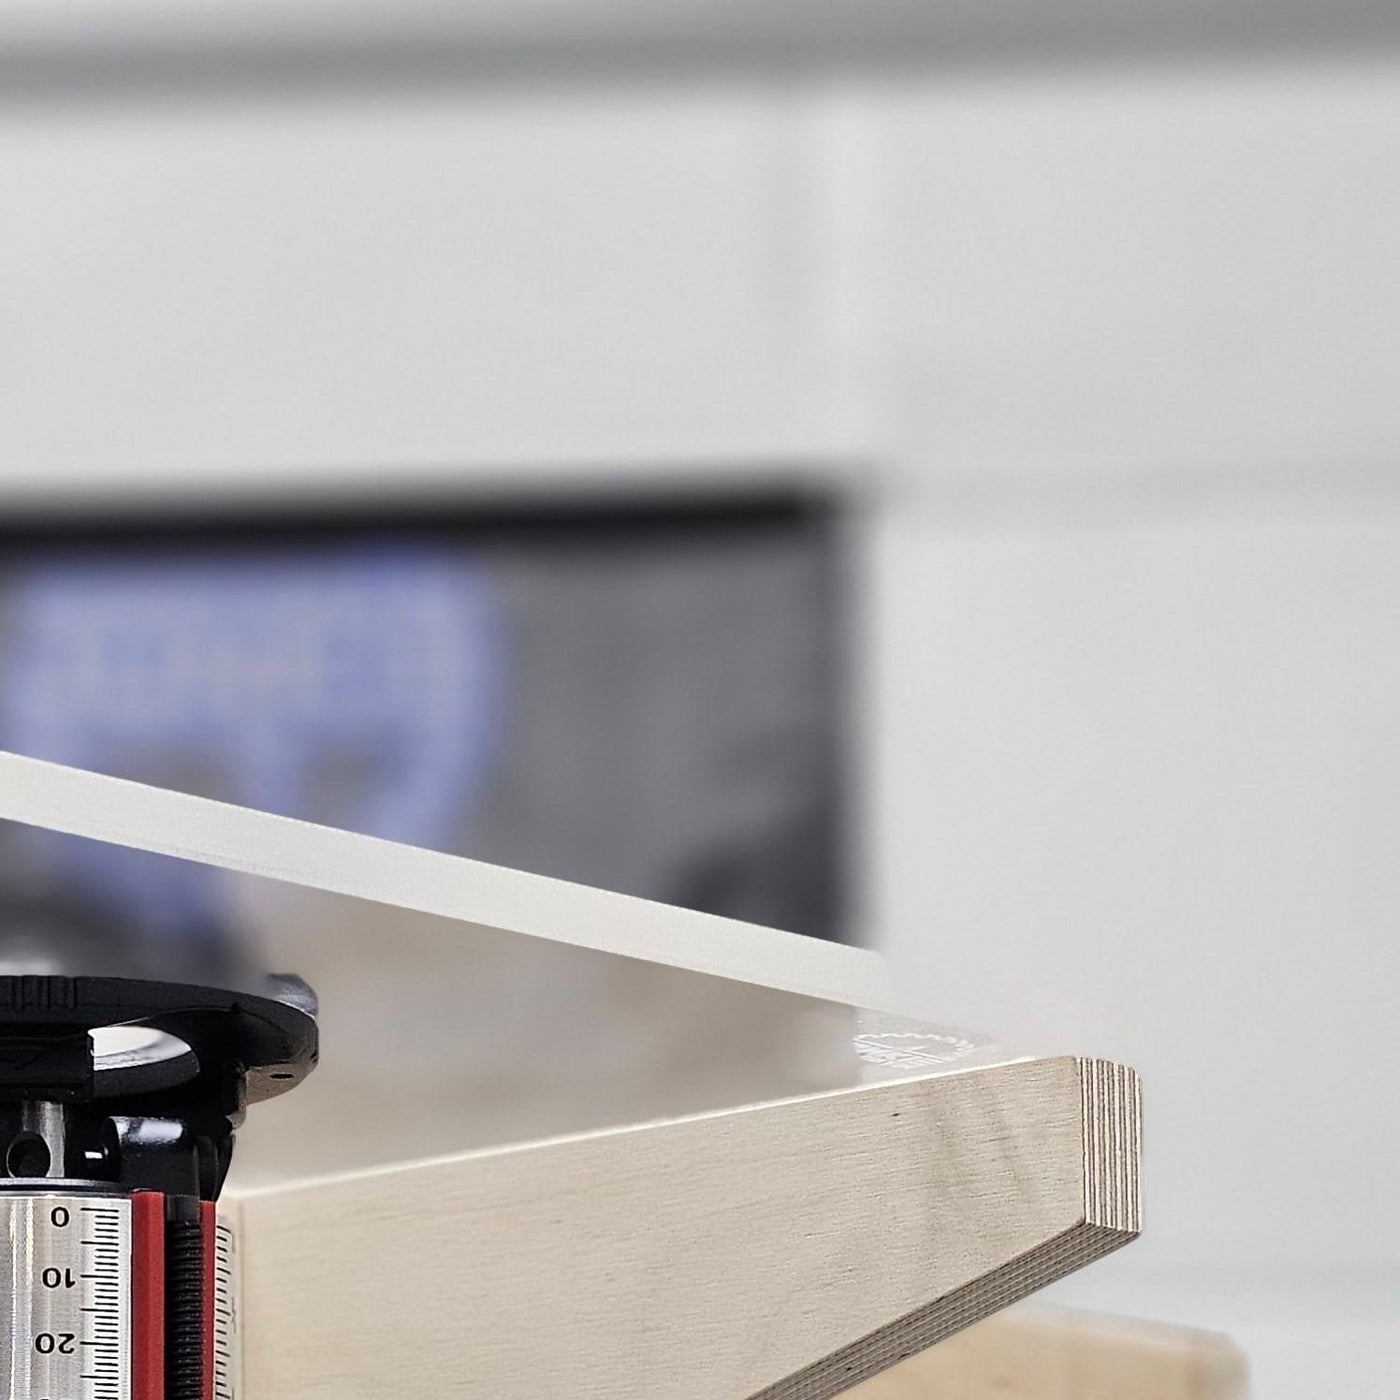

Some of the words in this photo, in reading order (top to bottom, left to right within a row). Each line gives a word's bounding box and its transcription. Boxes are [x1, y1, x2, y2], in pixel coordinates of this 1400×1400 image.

[50, 1207, 70, 1227] 0
[42, 1268, 76, 1288] 10
[35, 1333, 75, 1354] 20
